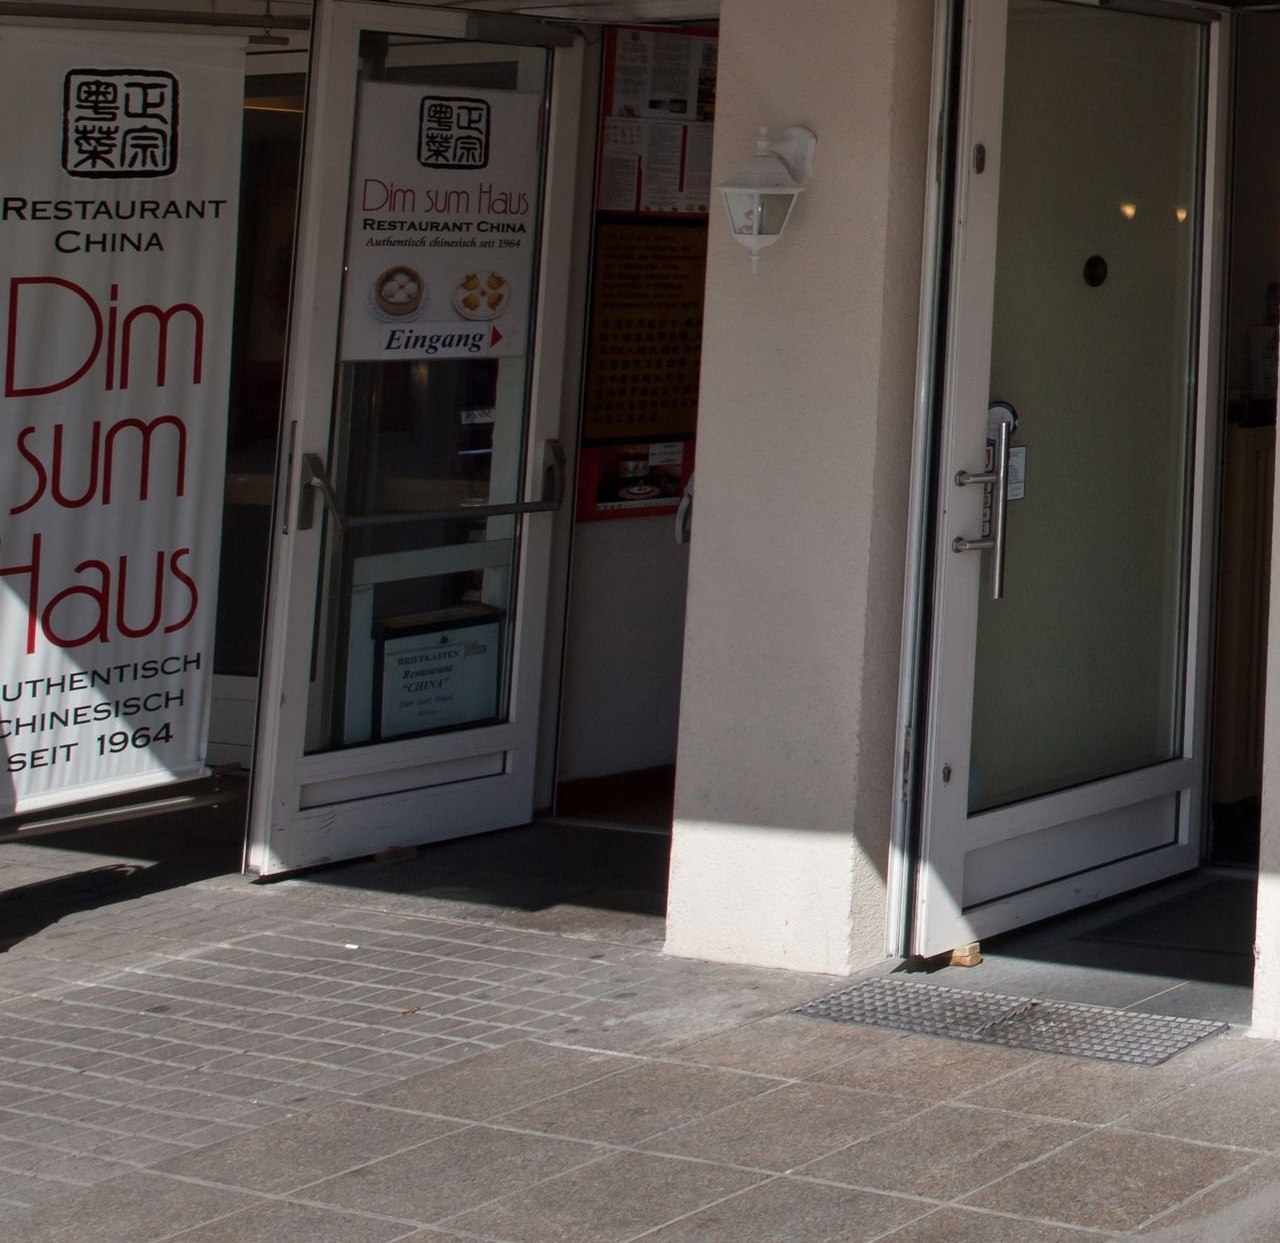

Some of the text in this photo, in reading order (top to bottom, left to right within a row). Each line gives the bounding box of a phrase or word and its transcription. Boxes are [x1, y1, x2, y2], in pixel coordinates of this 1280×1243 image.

[362, 178, 529, 215] Dim sum Haus
[2, 197, 227, 221] RESTAURANT
[362, 218, 526, 233] RESTAURANT CHINA
[54, 230, 165, 254] CHINA
[365, 236, 521, 248] Authentisch chinesisch seit 1964
[5, 276, 204, 397] Dim
[384, 329, 485, 354] Eingang
[10, 415, 187, 515] sum
[398, 650, 459, 666] BRIEFKASTEN
[402, 665, 454, 679] Restaurant
[0, 688, 185, 739] CHINESISCH
[7, 722, 173, 773] SEIT 1964
